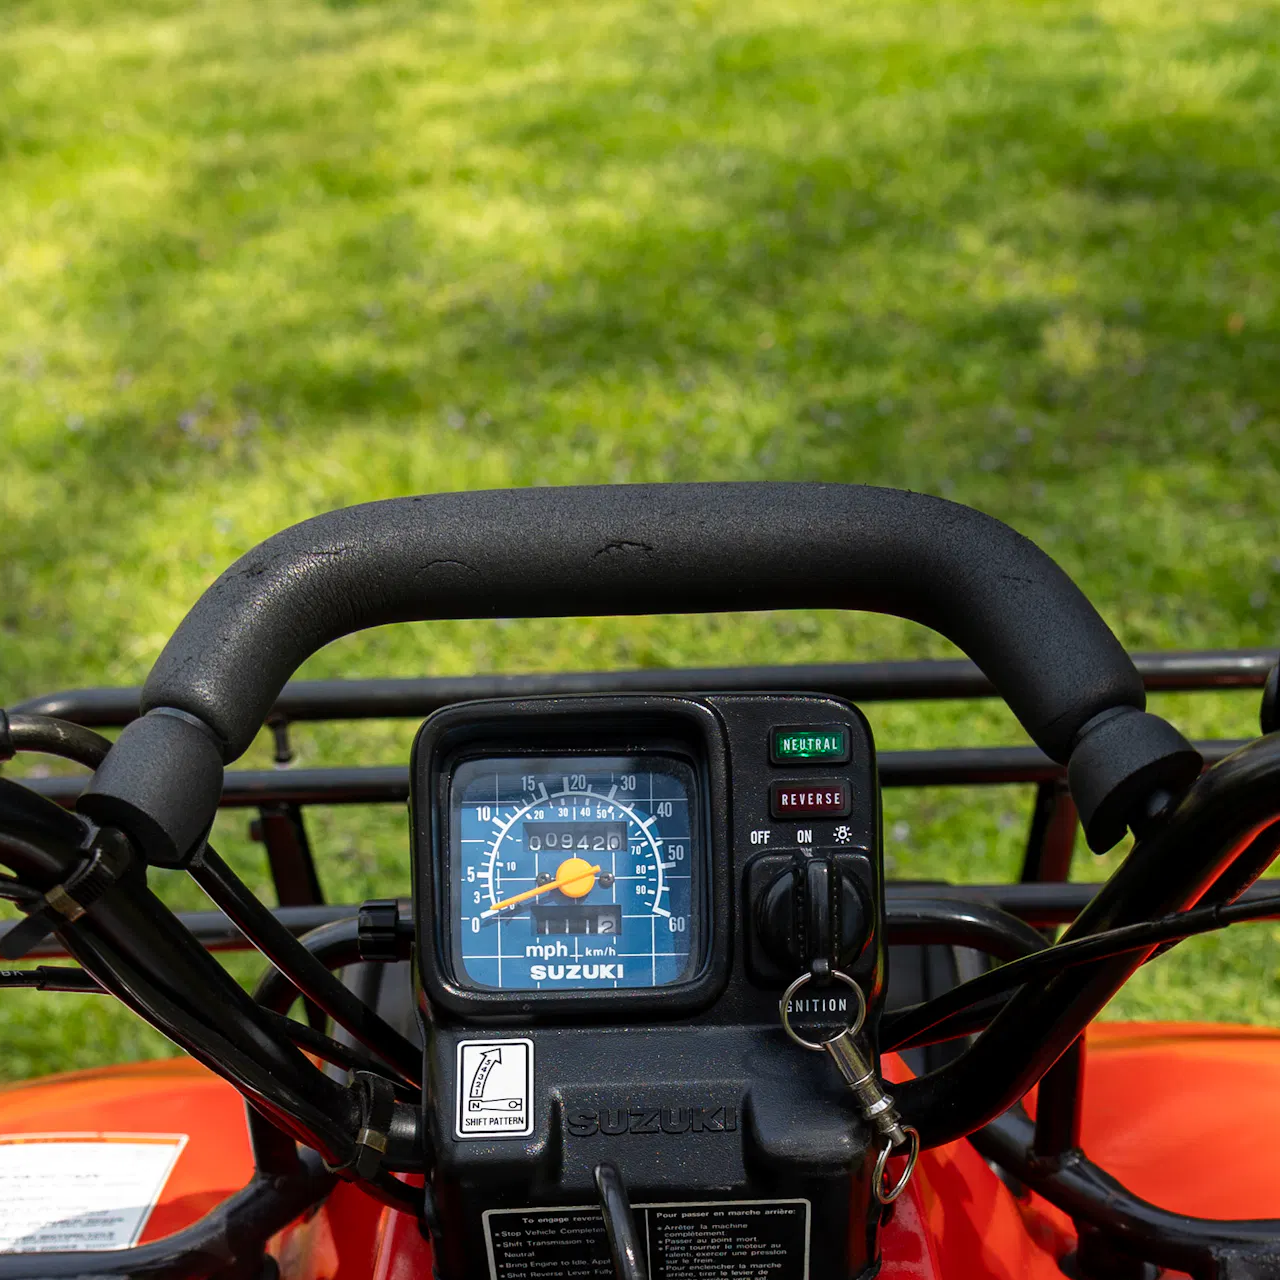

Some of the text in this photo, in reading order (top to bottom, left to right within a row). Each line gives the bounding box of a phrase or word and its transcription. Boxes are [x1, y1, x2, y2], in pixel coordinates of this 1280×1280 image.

[783, 737, 838, 751] NEUTRAL
[521, 775, 536, 791] 15
[571, 774, 587, 790] 20
[620, 775, 636, 791] 30
[781, 792, 840, 806] REVERSE
[475, 806, 491, 822] 10
[533, 809, 545, 820] 20
[557, 807, 569, 818] 30
[580, 807, 591, 818] 40
[596, 809, 608, 819] 50
[656, 801, 673, 818] 40
[750, 829, 813, 845] OFF ON
[630, 845, 642, 856] 70
[668, 845, 685, 861] 50
[506, 860, 517, 871] 10
[635, 864, 647, 875] 80
[466, 866, 476, 882] 5
[635, 884, 647, 895] 90
[473, 890, 481, 904] 3
[471, 916, 480, 934] 0
[668, 916, 686, 933] 60
[525, 940, 617, 960] mph km/h
[530, 964, 624, 980] SUZUKI
[477, 1073, 484, 1081] 3
[465, 1116, 524, 1127] SHIFT PATTERN
[567, 1104, 738, 1137] SUZUKI
[681, 1210, 709, 1219] passer
[727, 1208, 762, 1216] marche
[537, 1216, 570, 1225] engage
[700, 1222, 708, 1230] la
[711, 1221, 748, 1230] machine
[501, 1230, 522, 1238] Stop
[525, 1228, 557, 1236] Vehicle
[502, 1240, 523, 1248] Shift
[526, 1238, 583, 1248] Transmission
[664, 1237, 693, 1245] Passer
[710, 1236, 733, 1244] point
[506, 1268, 614, 1279] Shift Reverse Lever Fully
